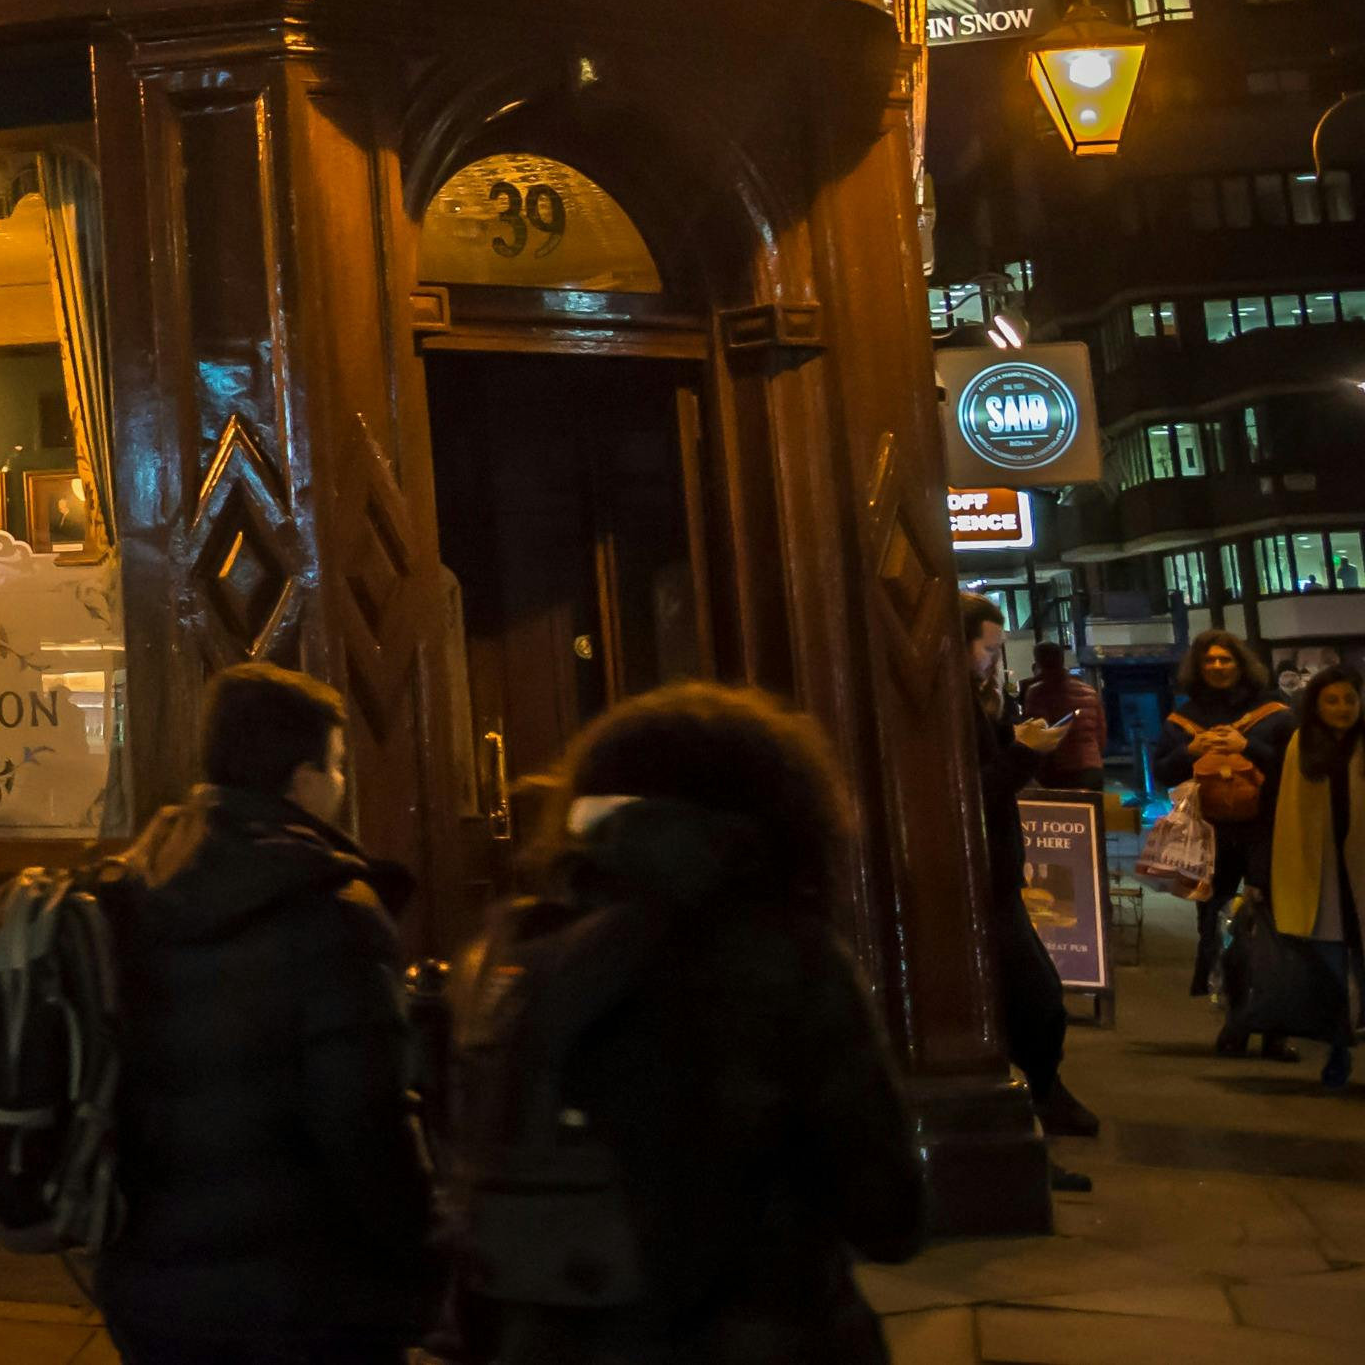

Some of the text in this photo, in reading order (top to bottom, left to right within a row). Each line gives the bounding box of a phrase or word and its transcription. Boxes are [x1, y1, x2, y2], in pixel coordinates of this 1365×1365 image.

[959, 8, 1034, 35] SNOW
[488, 181, 567, 258] 39
[985, 394, 1049, 433] SAID
[947, 493, 989, 510] OFF
[1042, 821, 1086, 835] FOOD
[1036, 837, 1072, 849] HERE
